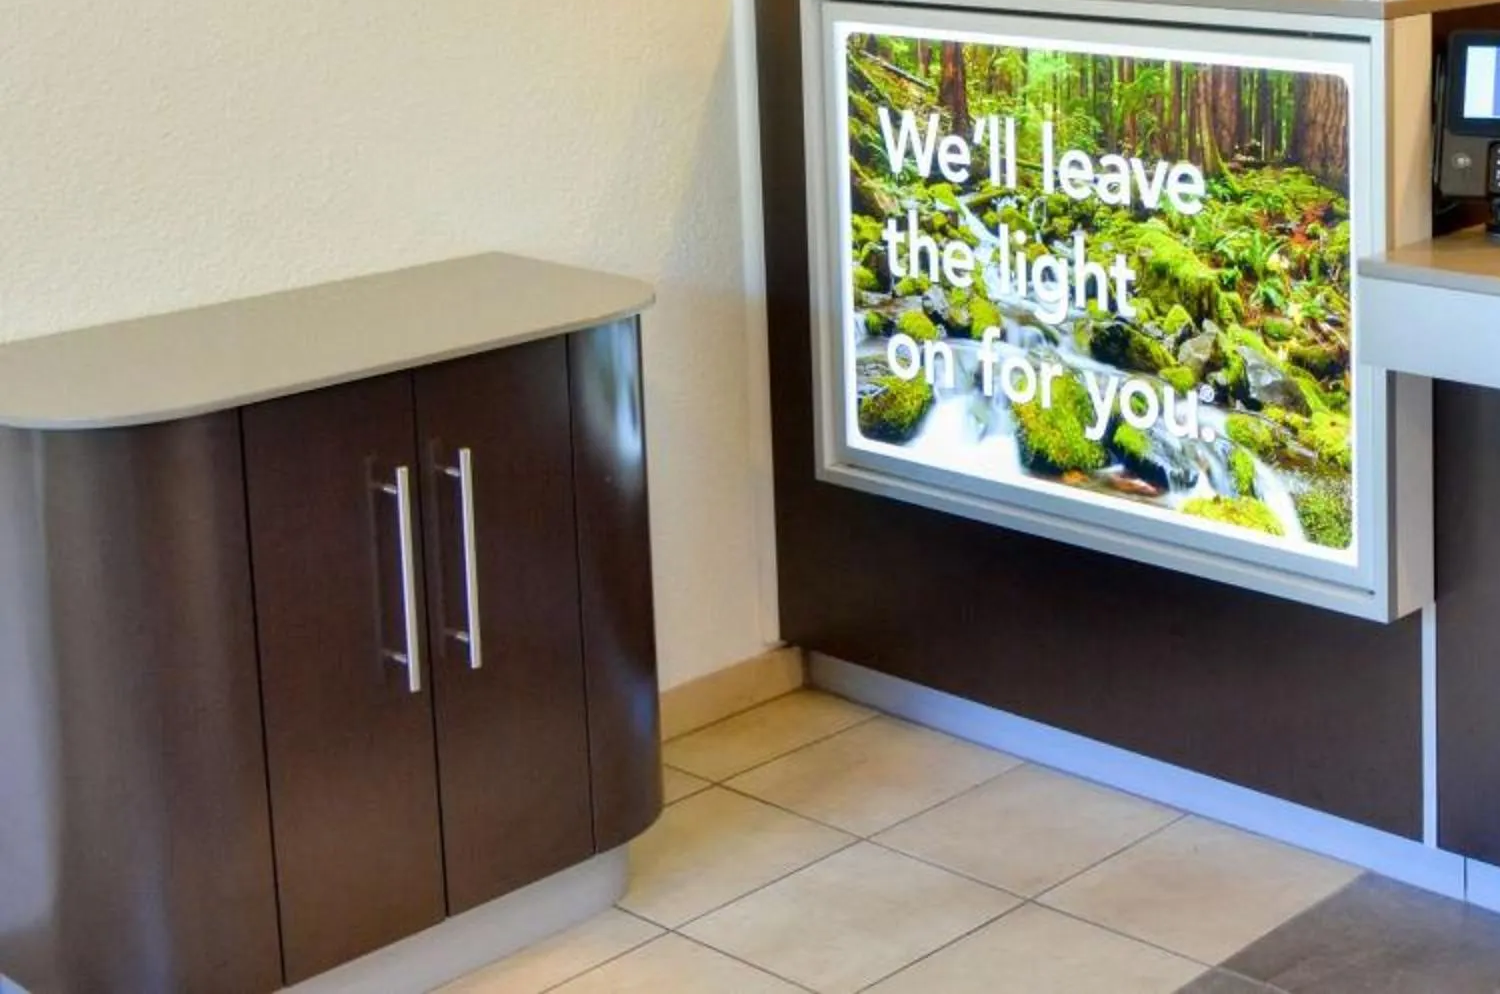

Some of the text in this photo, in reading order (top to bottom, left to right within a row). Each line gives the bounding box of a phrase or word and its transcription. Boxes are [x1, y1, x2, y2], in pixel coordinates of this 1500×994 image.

[878, 107, 1206, 216] We'll leave
[882, 208, 1137, 325] the light
[886, 334, 955, 389] on
[977, 327, 1063, 410] for
